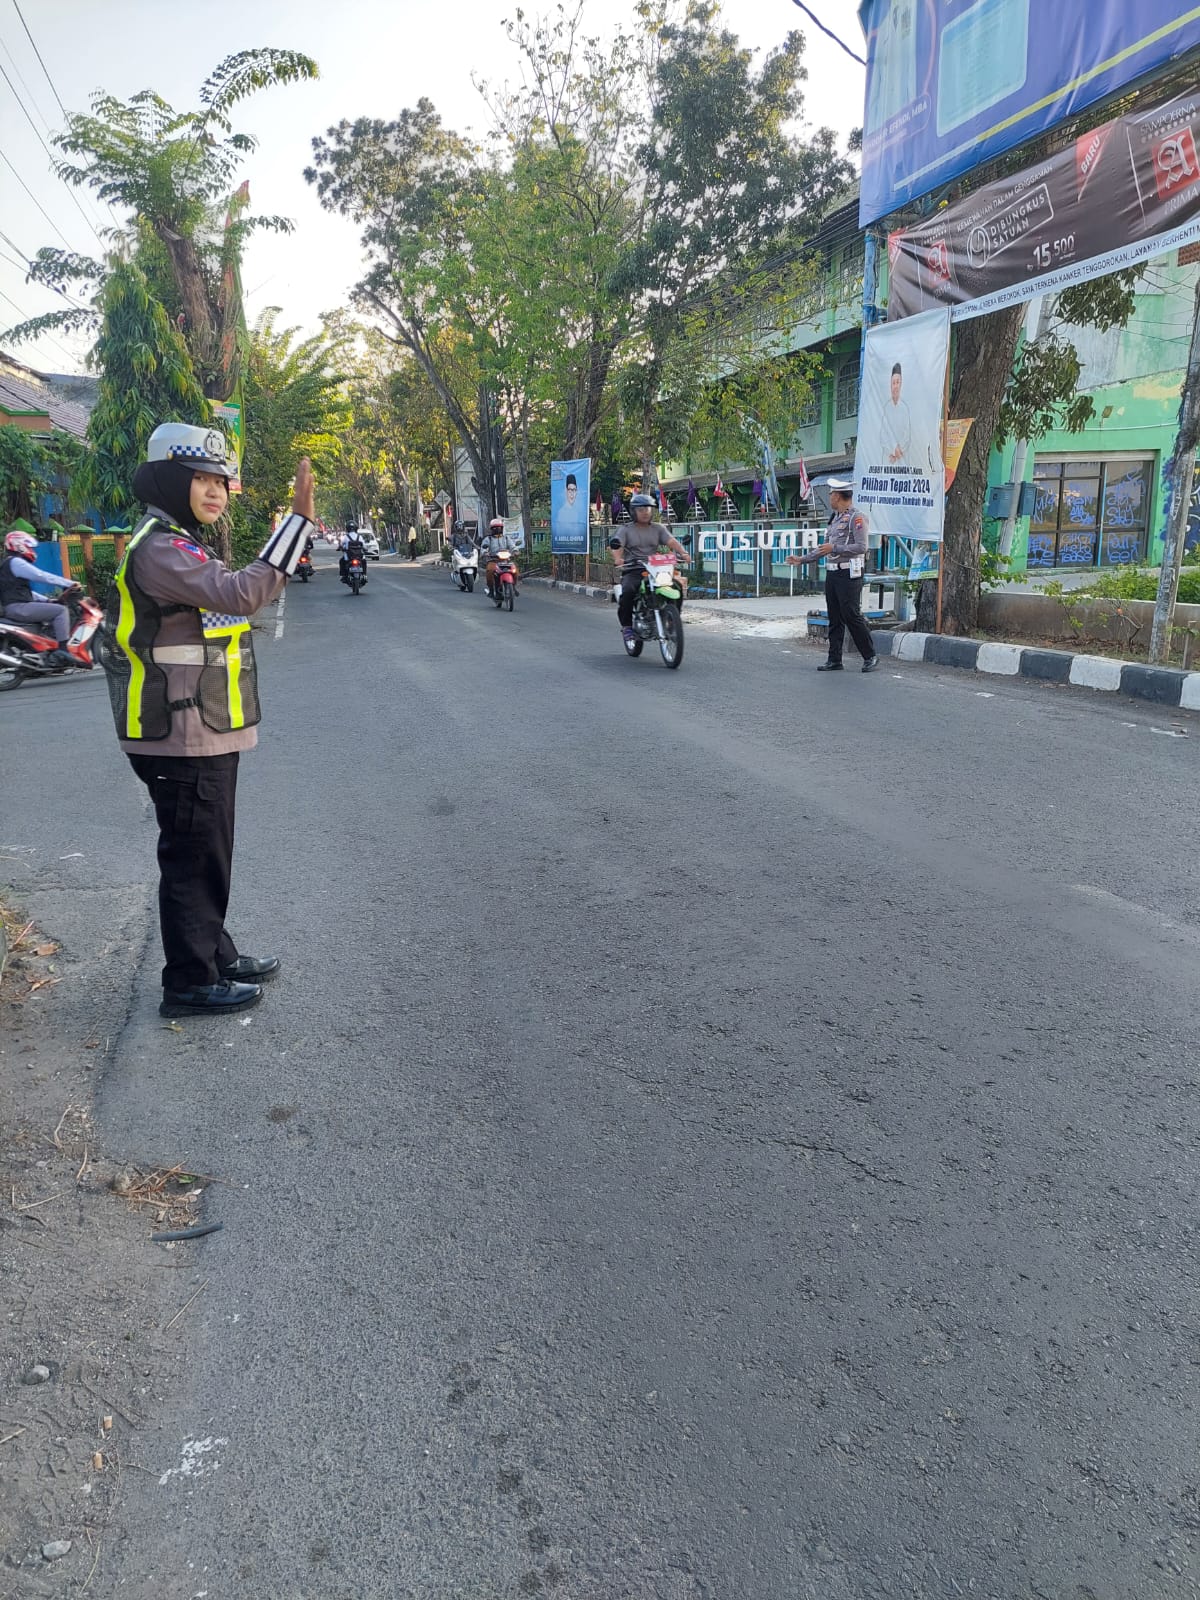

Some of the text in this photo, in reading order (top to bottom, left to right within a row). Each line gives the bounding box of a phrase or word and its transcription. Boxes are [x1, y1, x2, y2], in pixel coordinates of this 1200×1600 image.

[1140, 102, 1196, 135] SAMPOERNA
[1080, 135, 1101, 174] BARU
[993, 190, 1014, 208] DALAM
[1164, 185, 1200, 216] PRIMA
[990, 194, 1046, 237] DIBUNGKUS
[993, 217, 1030, 248] SATUAN
[1022, 285, 1034, 296] SAYA
[1035, 277, 1059, 291] TERKENA
[1060, 268, 1082, 283] KANKER
[861, 477, 931, 494] Pilihan Tepat 2024
